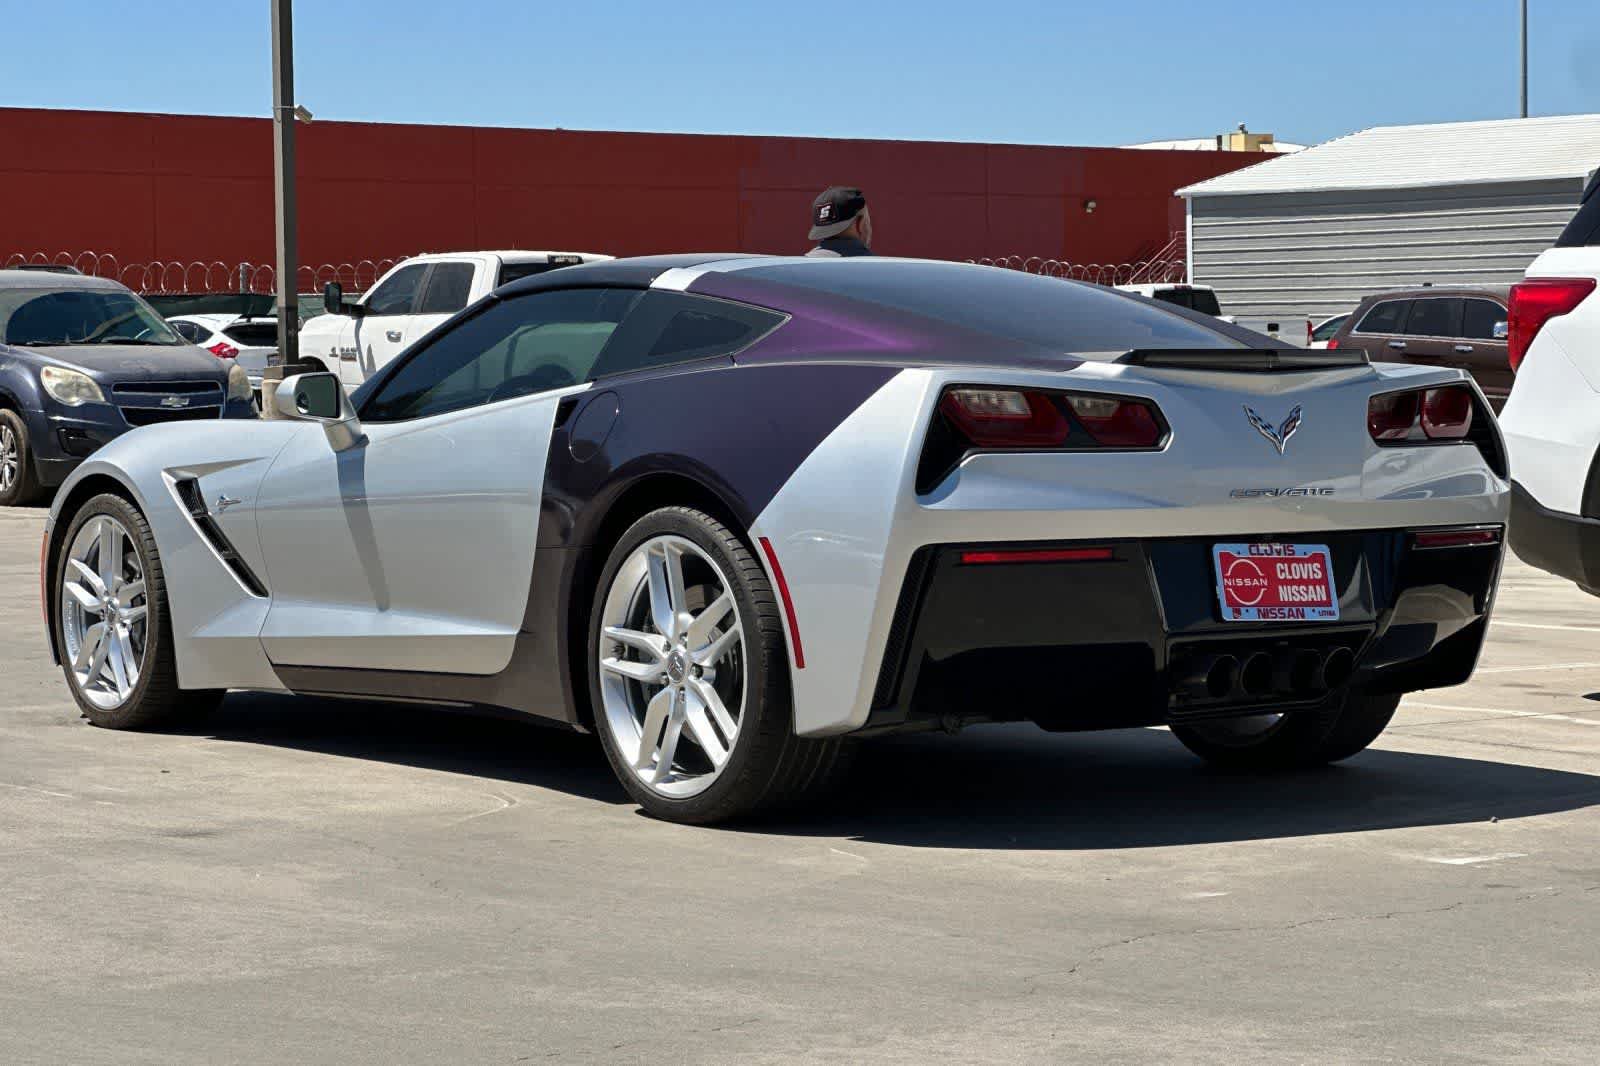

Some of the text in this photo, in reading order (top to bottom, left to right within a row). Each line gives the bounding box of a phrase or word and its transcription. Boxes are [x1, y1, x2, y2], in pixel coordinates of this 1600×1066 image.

[1248, 544, 1296, 556] CLOVIS
[1276, 562, 1322, 580] CLOVIS
[1224, 578, 1268, 586] NISSAN
[1278, 585, 1327, 602] NISSAN
[1257, 607, 1306, 619] NISSAN
